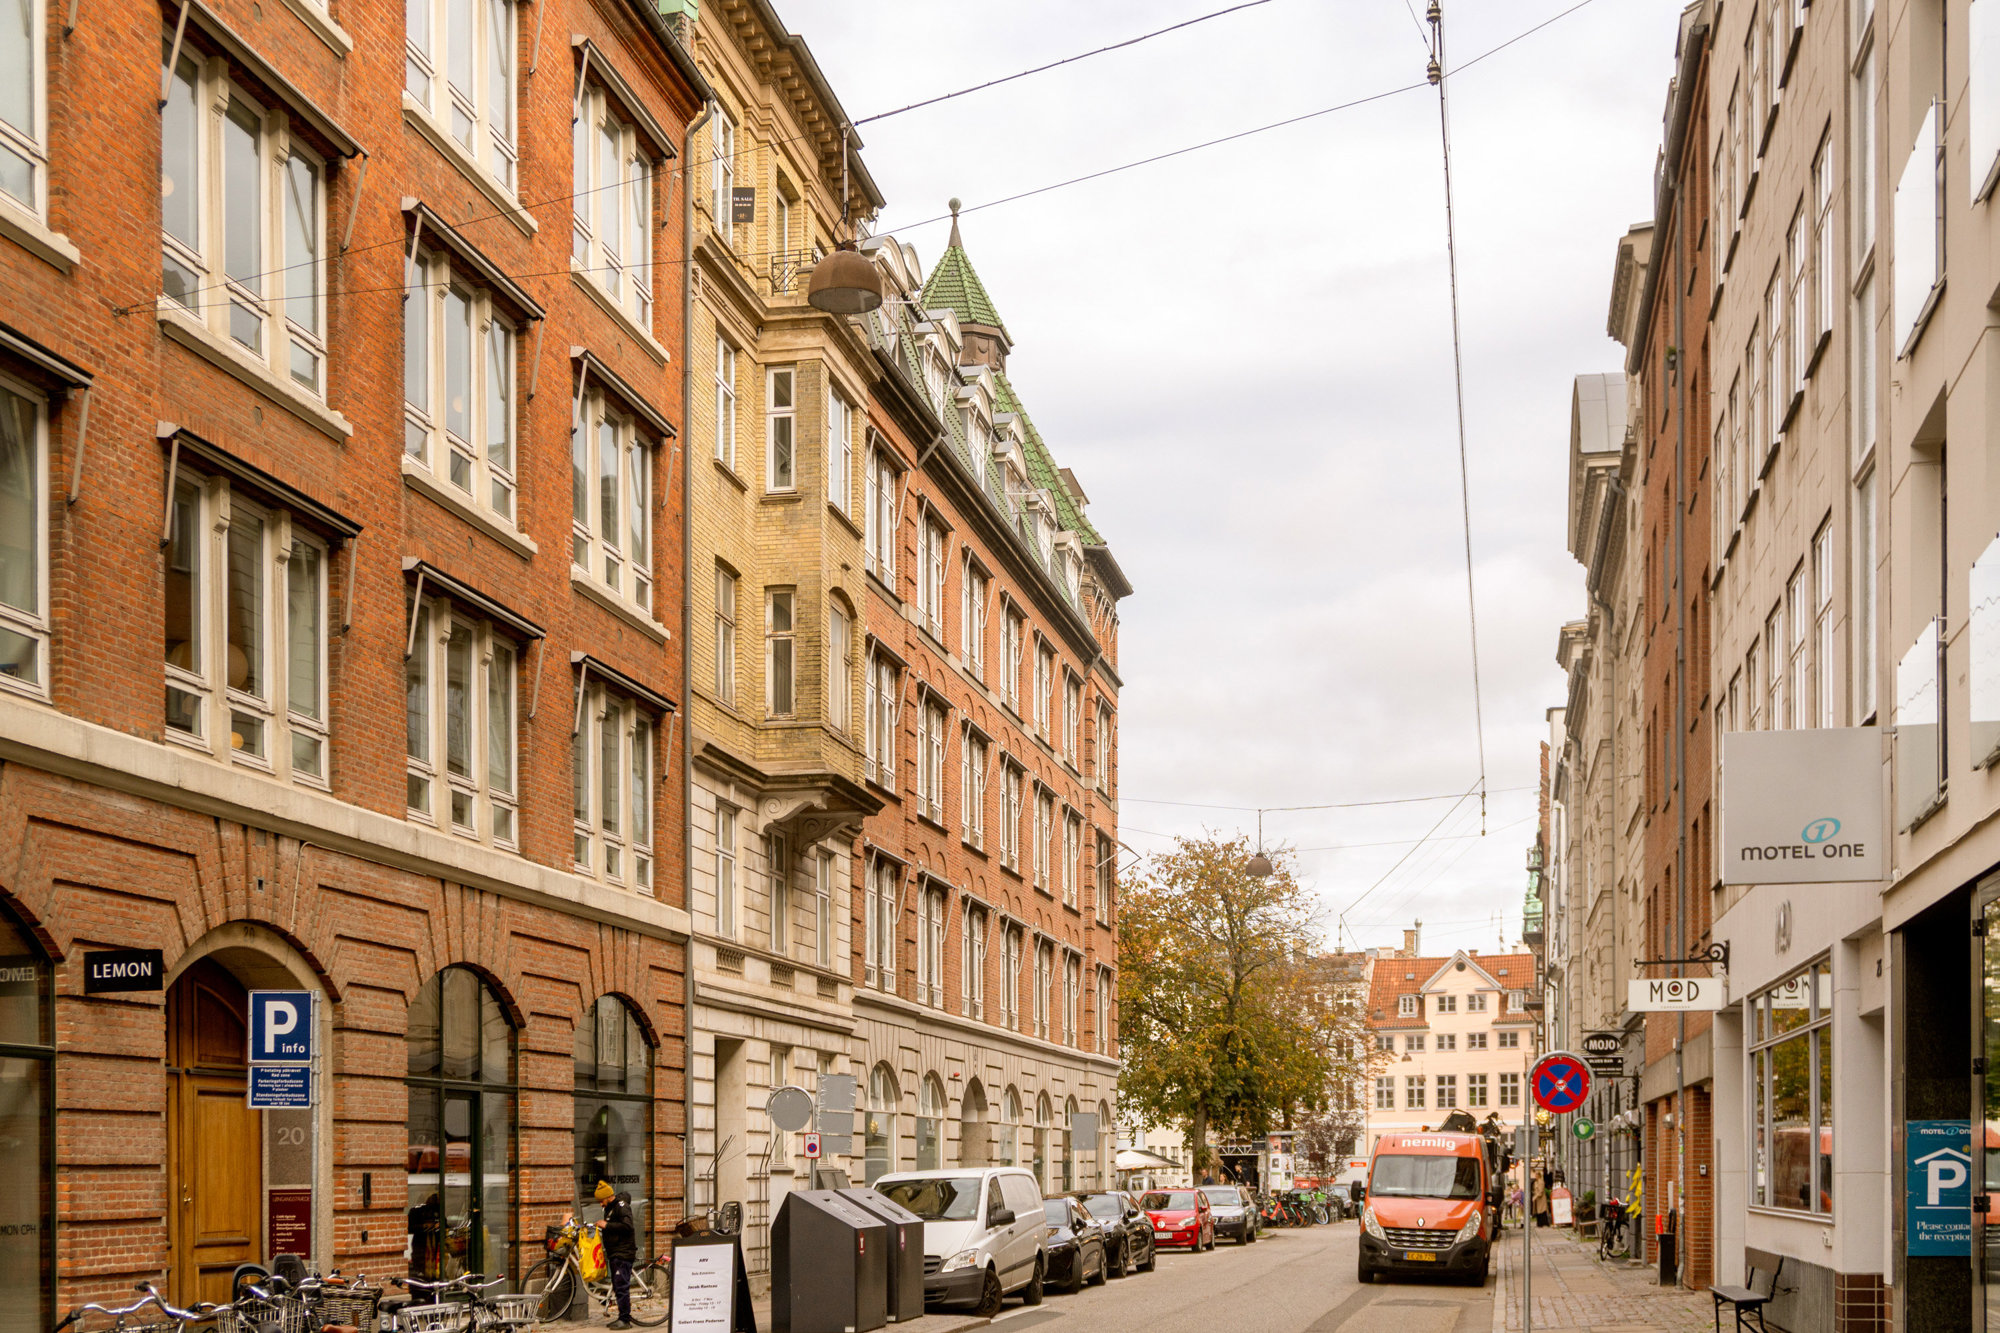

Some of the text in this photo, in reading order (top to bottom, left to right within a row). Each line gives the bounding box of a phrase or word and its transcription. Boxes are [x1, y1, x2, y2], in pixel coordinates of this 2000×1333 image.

[1741, 844, 1865, 861] MOTEL ONE
[93, 962, 152, 979] LEMON
[1650, 981, 1699, 1003] MOD
[265, 1000, 298, 1053] P
[282, 1043, 306, 1053] info
[1589, 1039, 1616, 1050] MOJO
[277, 1127, 305, 1145] 20
[1402, 1138, 1456, 1151] nemlig
[1927, 1160, 1967, 1205] P
[21, 1224, 36, 1235] CPH
[1916, 1220, 1971, 1230] Please contac
[1919, 1231, 1932, 1240] the
